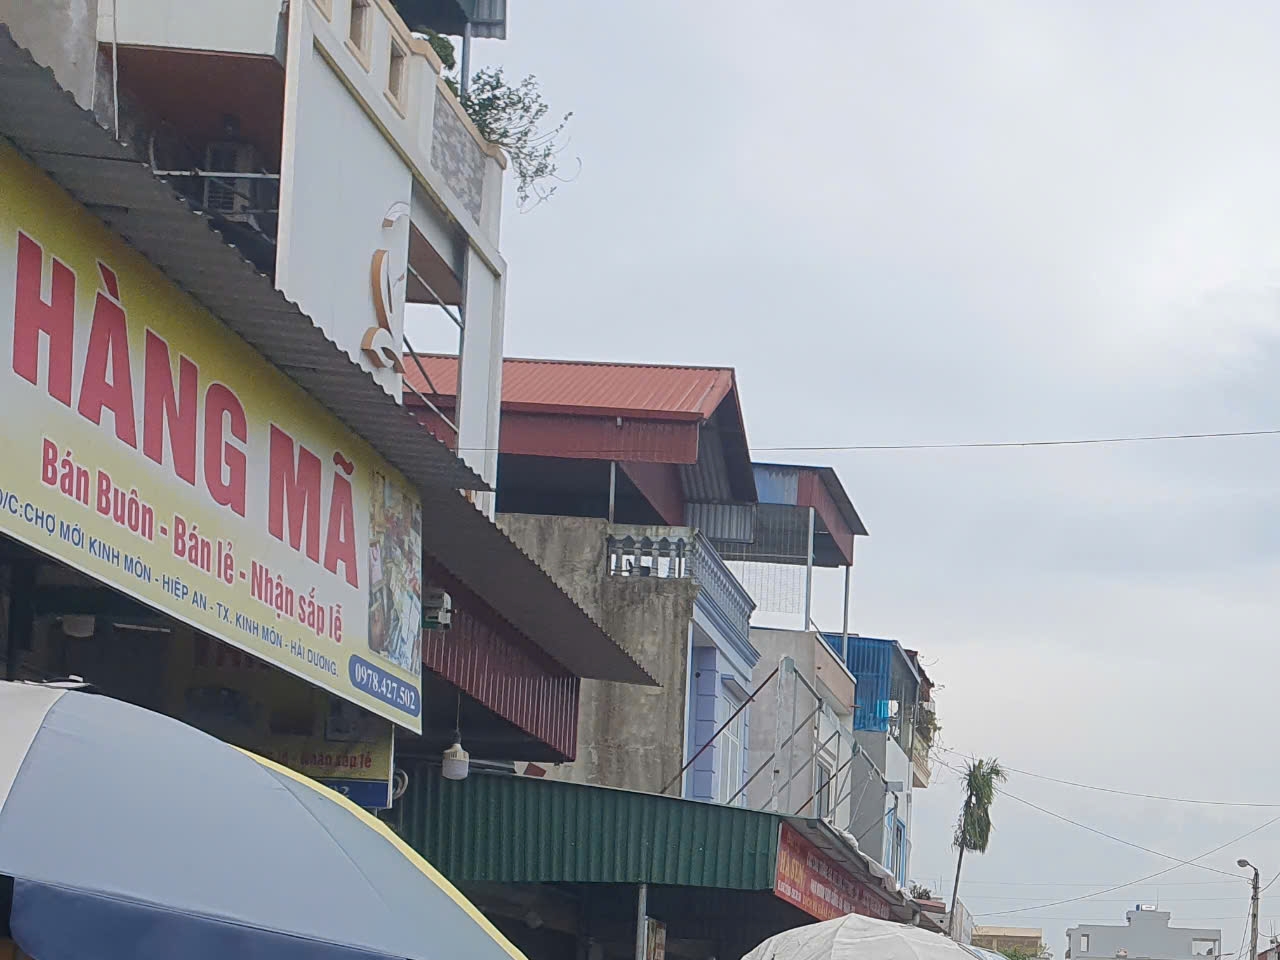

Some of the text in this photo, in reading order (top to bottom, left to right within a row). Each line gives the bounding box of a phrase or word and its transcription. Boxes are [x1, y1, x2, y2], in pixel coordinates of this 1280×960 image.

[13, 230, 359, 589] HÀNG MÃ
[0, 489, 56, 537] /C:CHỢ
[59, 520, 85, 549] MỚI
[89, 537, 120, 567] KINH
[124, 554, 152, 583] MÔN
[162, 574, 189, 601] HIỆP
[192, 590, 207, 611] AN
[216, 601, 233, 625] TX.
[235, 613, 259, 636] KINH
[261, 626, 283, 648] MÔN
[291, 637, 305, 660] HẢI
[42, 437, 90, 506] Bán
[97, 470, 153, 541] Buôn
[173, 515, 211, 573] Bán
[216, 540, 234, 585] lẻ
[251, 560, 294, 619] Nhận
[298, 587, 325, 636] sắp
[329, 604, 342, 644] lễ
[354, 662, 416, 710] 0978.427.502
